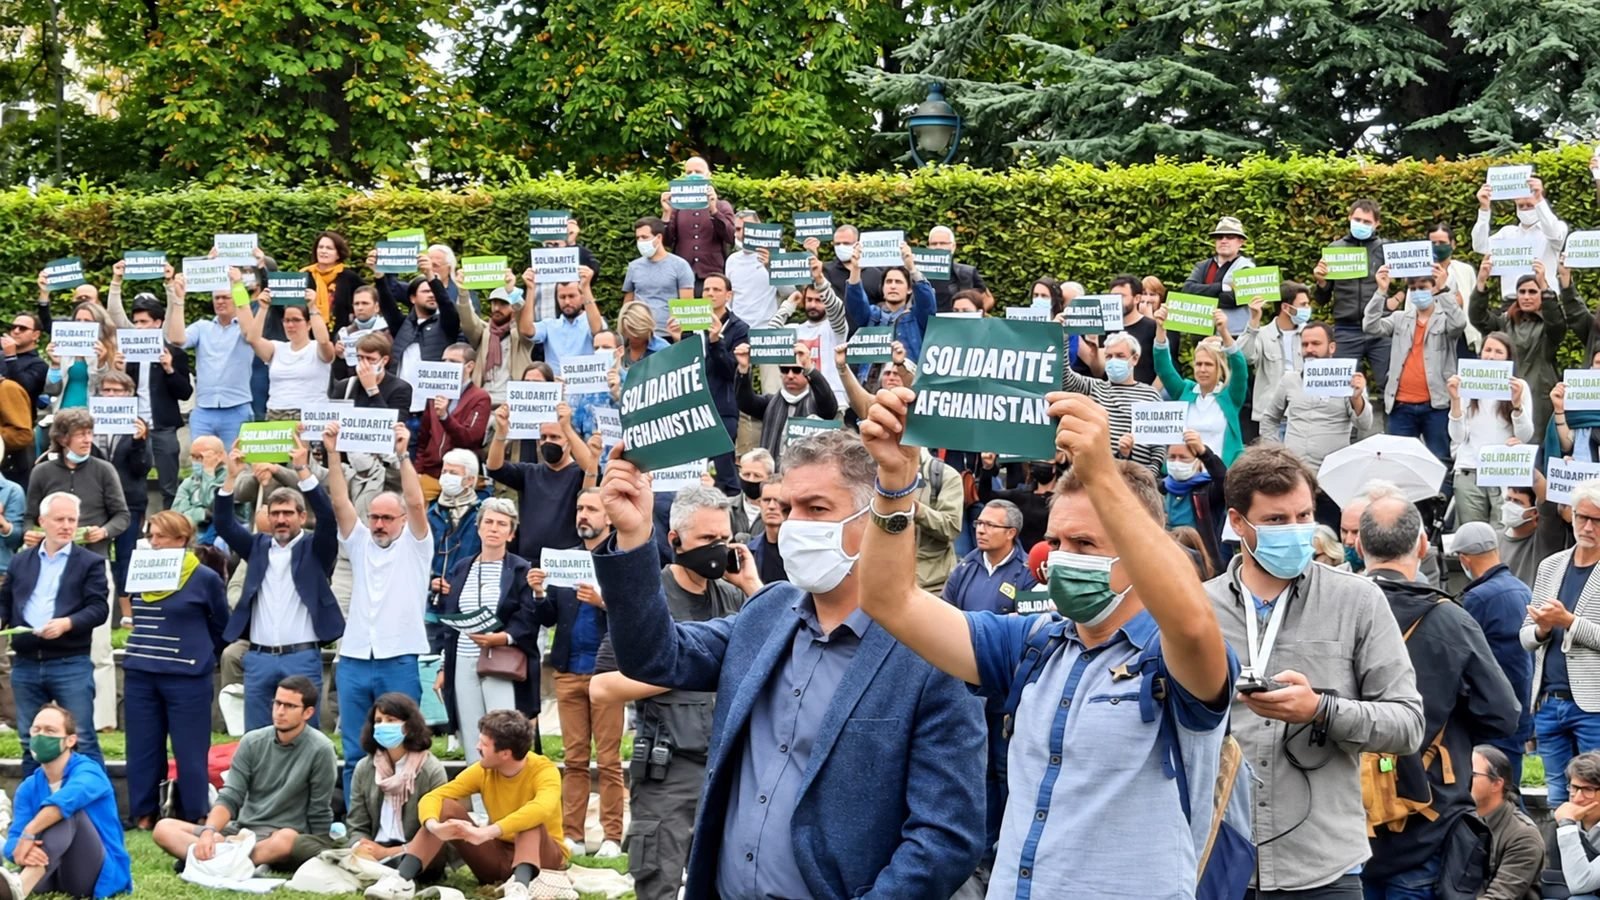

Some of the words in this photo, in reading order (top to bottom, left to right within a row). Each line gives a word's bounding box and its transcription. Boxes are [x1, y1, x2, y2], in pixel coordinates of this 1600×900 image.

[535, 255, 576, 264] SOLIDARITÉ
[922, 345, 1057, 384] SOLIDARITÉ
[1460, 367, 1509, 379] SOLIDARITÉ
[621, 356, 703, 415] SOLIDARITÉ
[1460, 381, 1509, 391] AFGHANISTAN
[510, 388, 558, 401] SOLIDARITÉ
[914, 389, 1050, 426] AFGHANISTAN
[304, 412, 340, 421] SOLIDARI
[1134, 410, 1184, 421] SOLIDARITÉ
[341, 416, 393, 429] SOLIDARITÉ
[623, 404, 717, 451] AFGHANISTAN
[1134, 426, 1184, 434] AFGHANISTAN
[340, 431, 391, 442] AFGHANISTAN
[1481, 452, 1531, 463] SOLIDARITÉ
[1480, 466, 1530, 477] AFGHANISTAN
